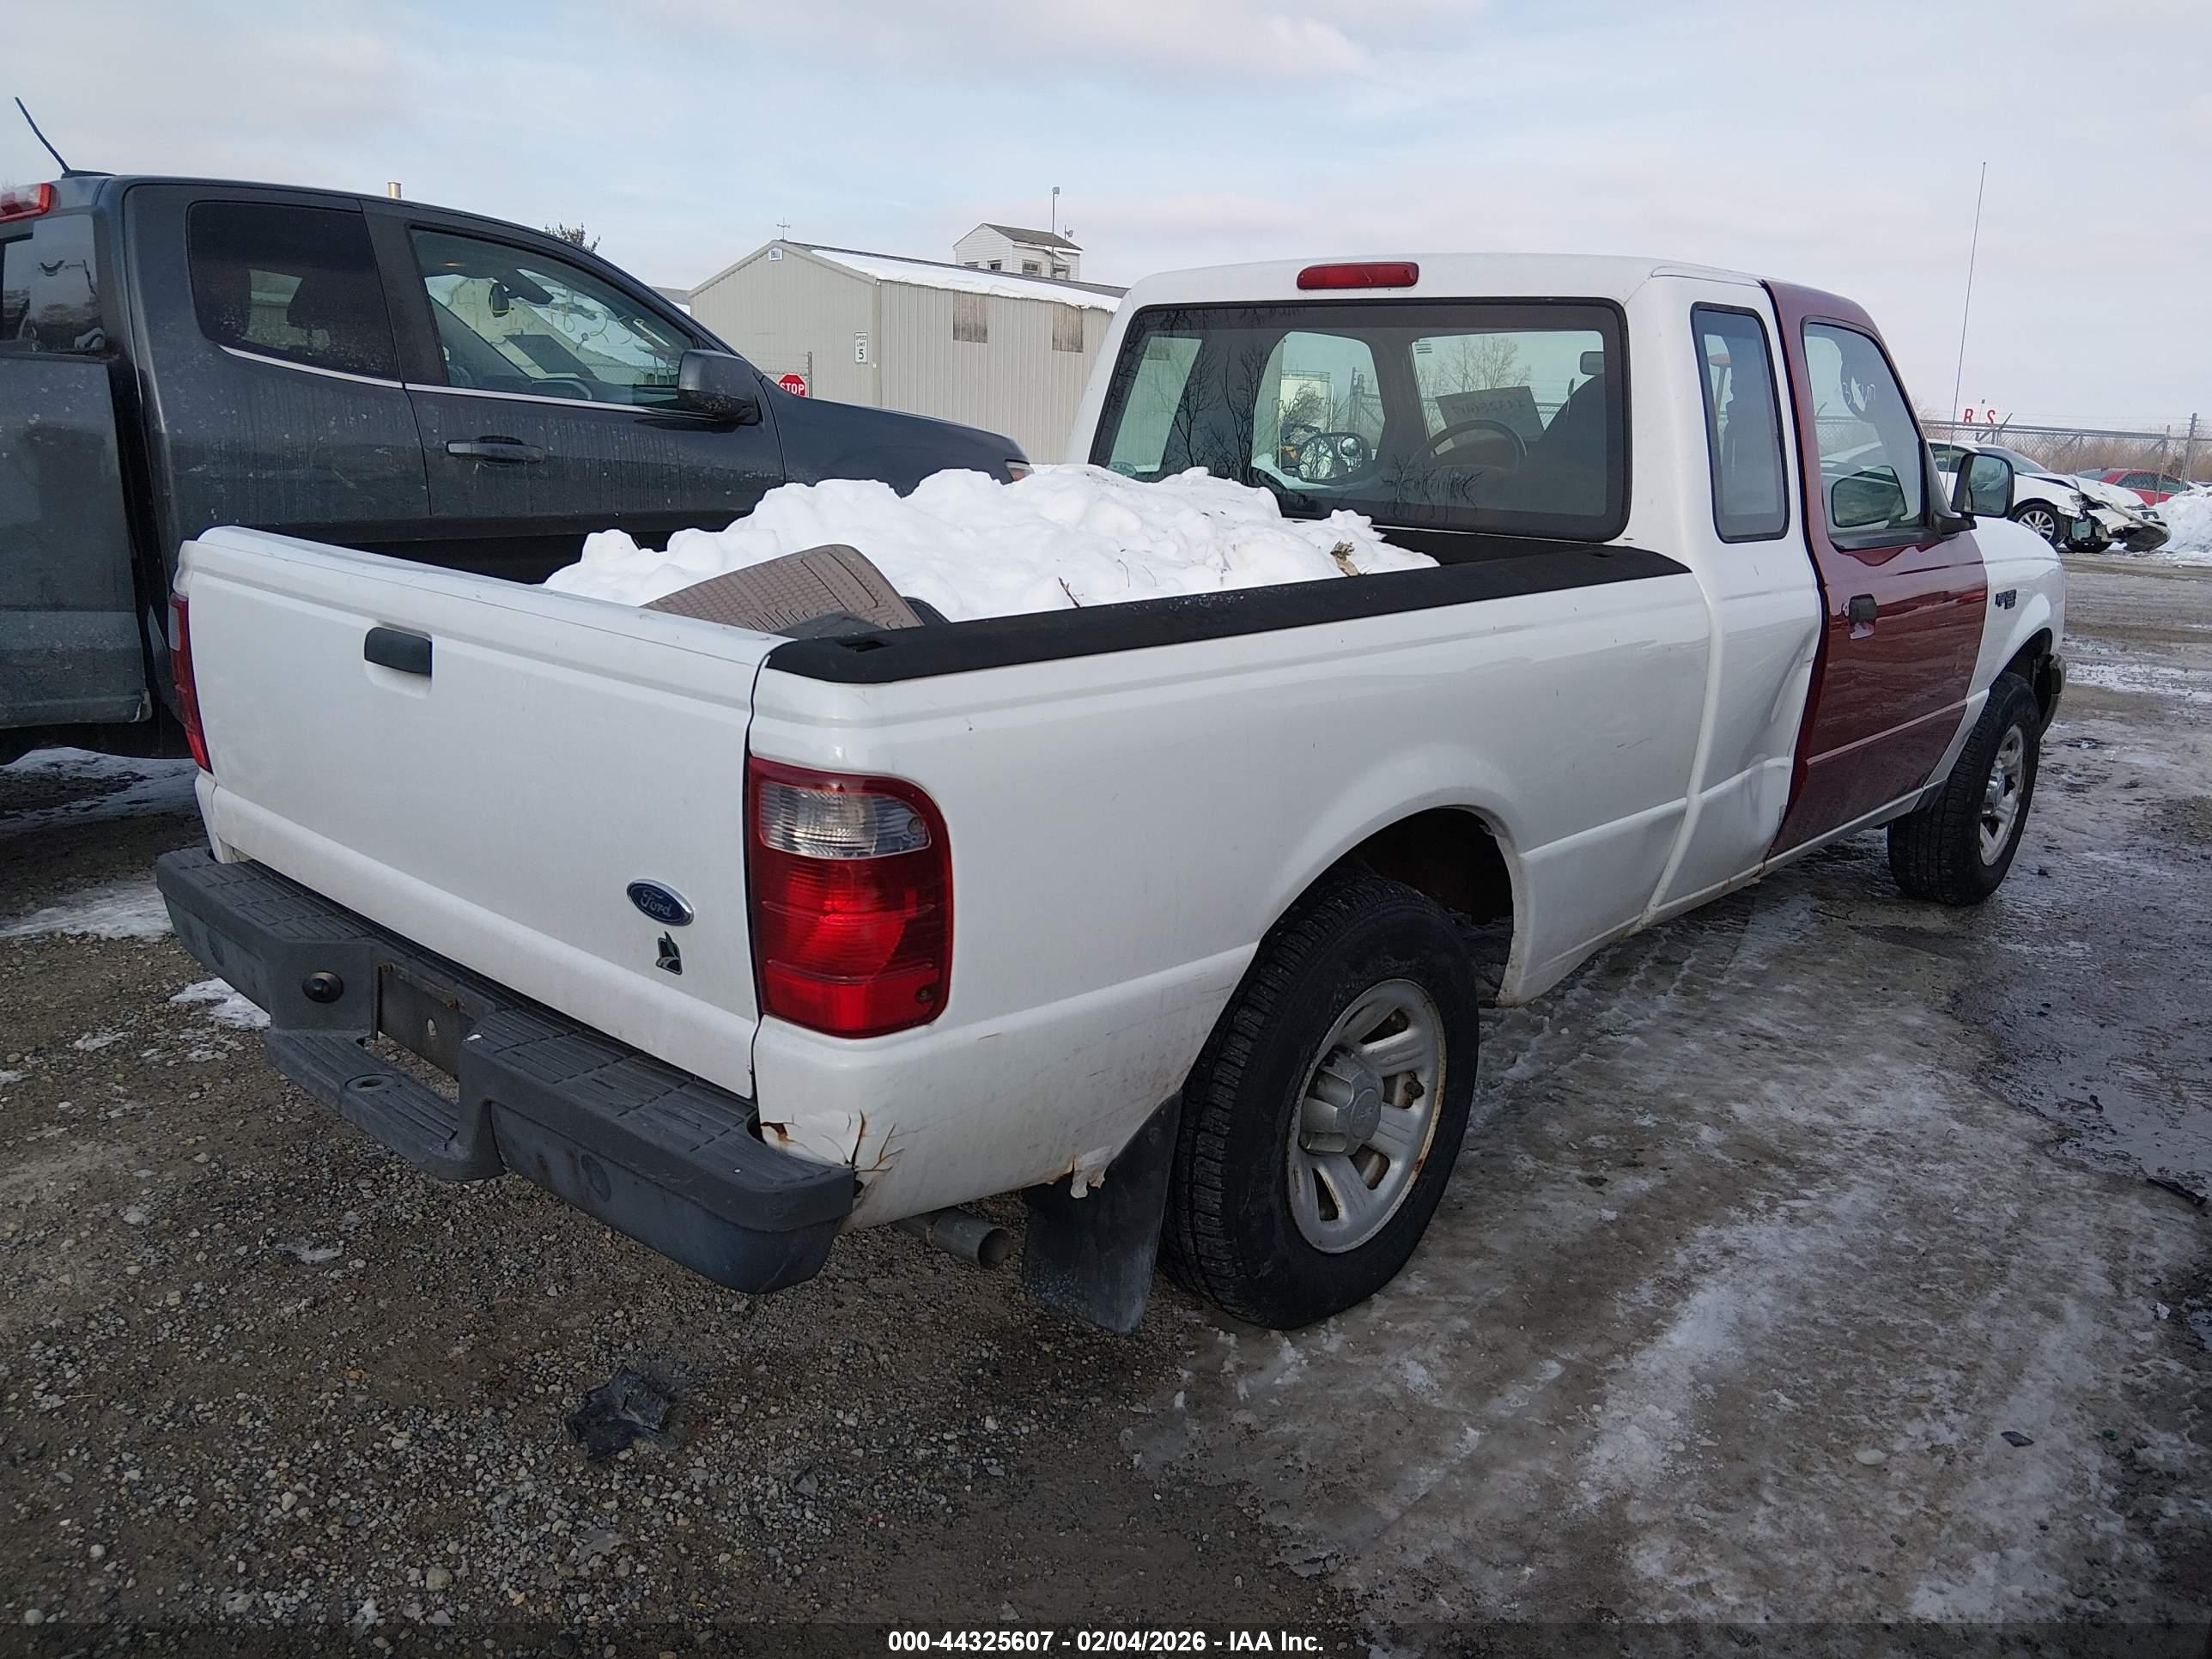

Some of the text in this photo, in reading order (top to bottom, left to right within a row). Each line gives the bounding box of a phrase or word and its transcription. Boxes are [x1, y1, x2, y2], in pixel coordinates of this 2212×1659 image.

[859, 348, 865, 360] 5
[780, 382, 805, 395] STOP
[640, 889, 673, 918] Ford
